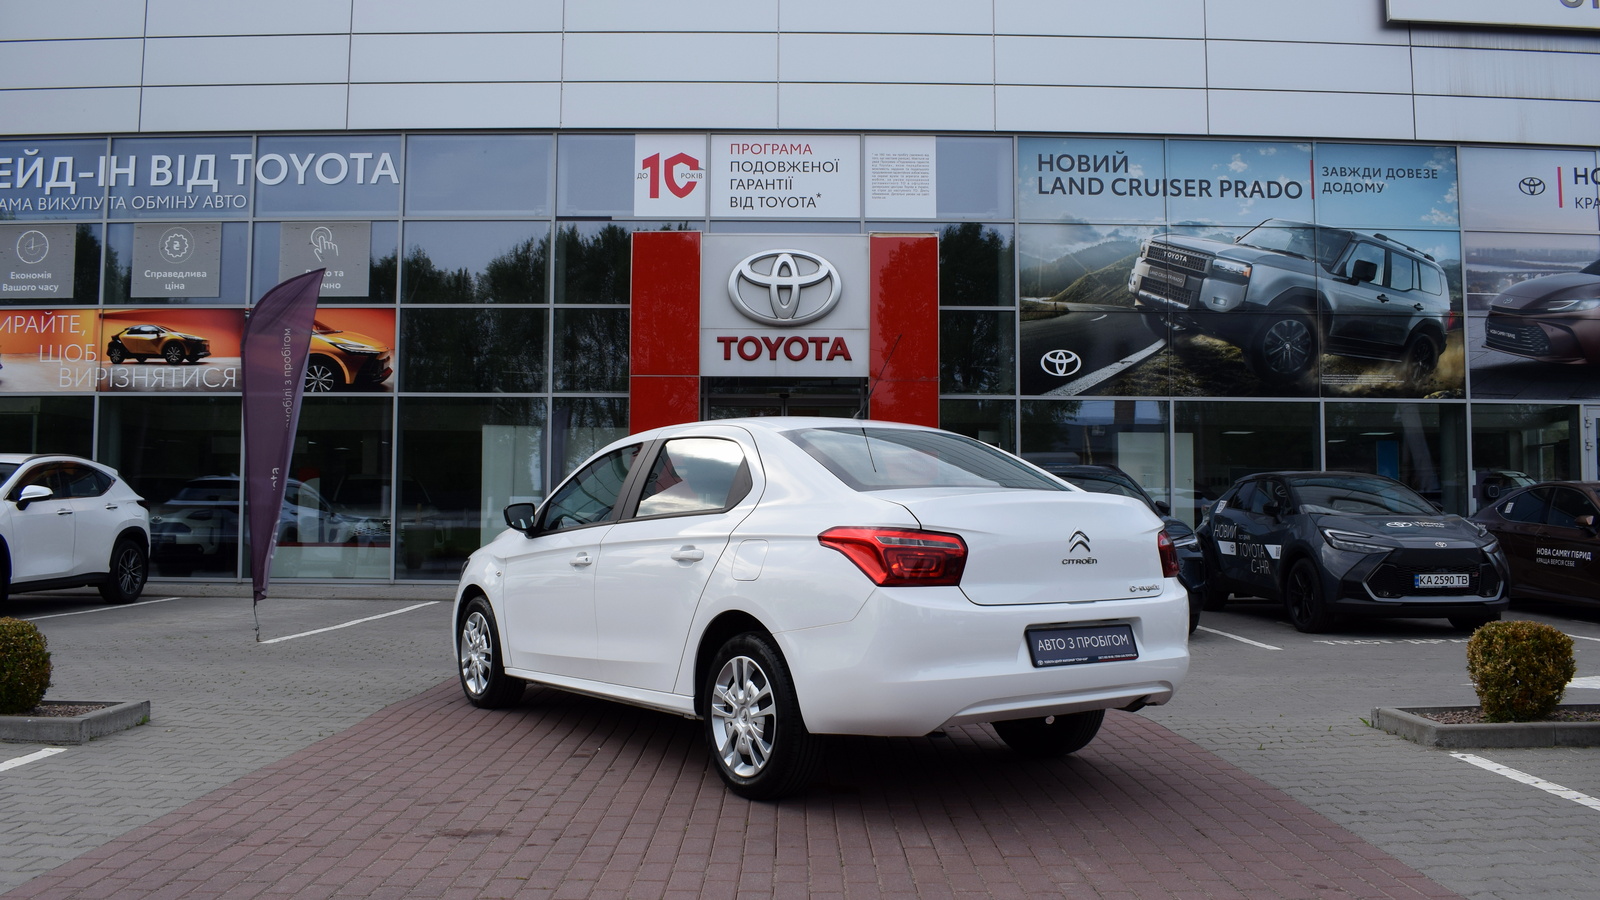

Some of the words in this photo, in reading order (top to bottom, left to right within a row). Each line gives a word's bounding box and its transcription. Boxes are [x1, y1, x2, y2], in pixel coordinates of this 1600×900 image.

[730, 143, 813, 155] ПРОГРАМА
[730, 158, 840, 174] ПОДОВЖЕНОЇ
[1038, 150, 1129, 173] НОВИЙ
[150, 154, 219, 193] ВІД
[230, 152, 399, 186] TOYOTA
[636, 172, 649, 180] ДО
[1322, 166, 1382, 179] ЗАВЖДИ
[1386, 168, 1438, 180] ДОВЕЗЕ
[730, 176, 794, 190] ГАРАНТІЇ
[1038, 176, 1105, 196] LAND
[1111, 178, 1213, 198] CRUISER
[1219, 179, 1303, 200] PRADO
[1322, 182, 1385, 195] ДОДОМУ
[38, 197, 104, 211] ВИКУПУ
[109, 196, 127, 209] ТА
[131, 195, 199, 209] ОБМІНУ
[203, 195, 247, 209] АВТО
[730, 196, 754, 210] ВІД
[1163, 251, 1187, 262] TOYOTA
[11, 271, 52, 280] Економія
[144, 269, 207, 279] Справедлива
[2, 284, 37, 292] Вашого
[39, 284, 59, 293] часу
[165, 281, 185, 290] ціна
[40, 344, 97, 365] ЩОБ
[281, 328, 293, 376] пробігом
[716, 336, 852, 361] TOYOTA
[59, 367, 236, 388] ВИРІЗНЯТИСЯ
[1213, 523, 1237, 538] НОВИЙ
[1239, 543, 1266, 558] TOYOTA
[1536, 548, 1552, 556] НОВА
[1552, 549, 1571, 558] CAMRY
[1251, 559, 1271, 574] C-HR
[1434, 576, 1455, 585] 2590
[1038, 638, 1066, 651] АВТО
[1076, 634, 1129, 649] ПРОБІГОМ
